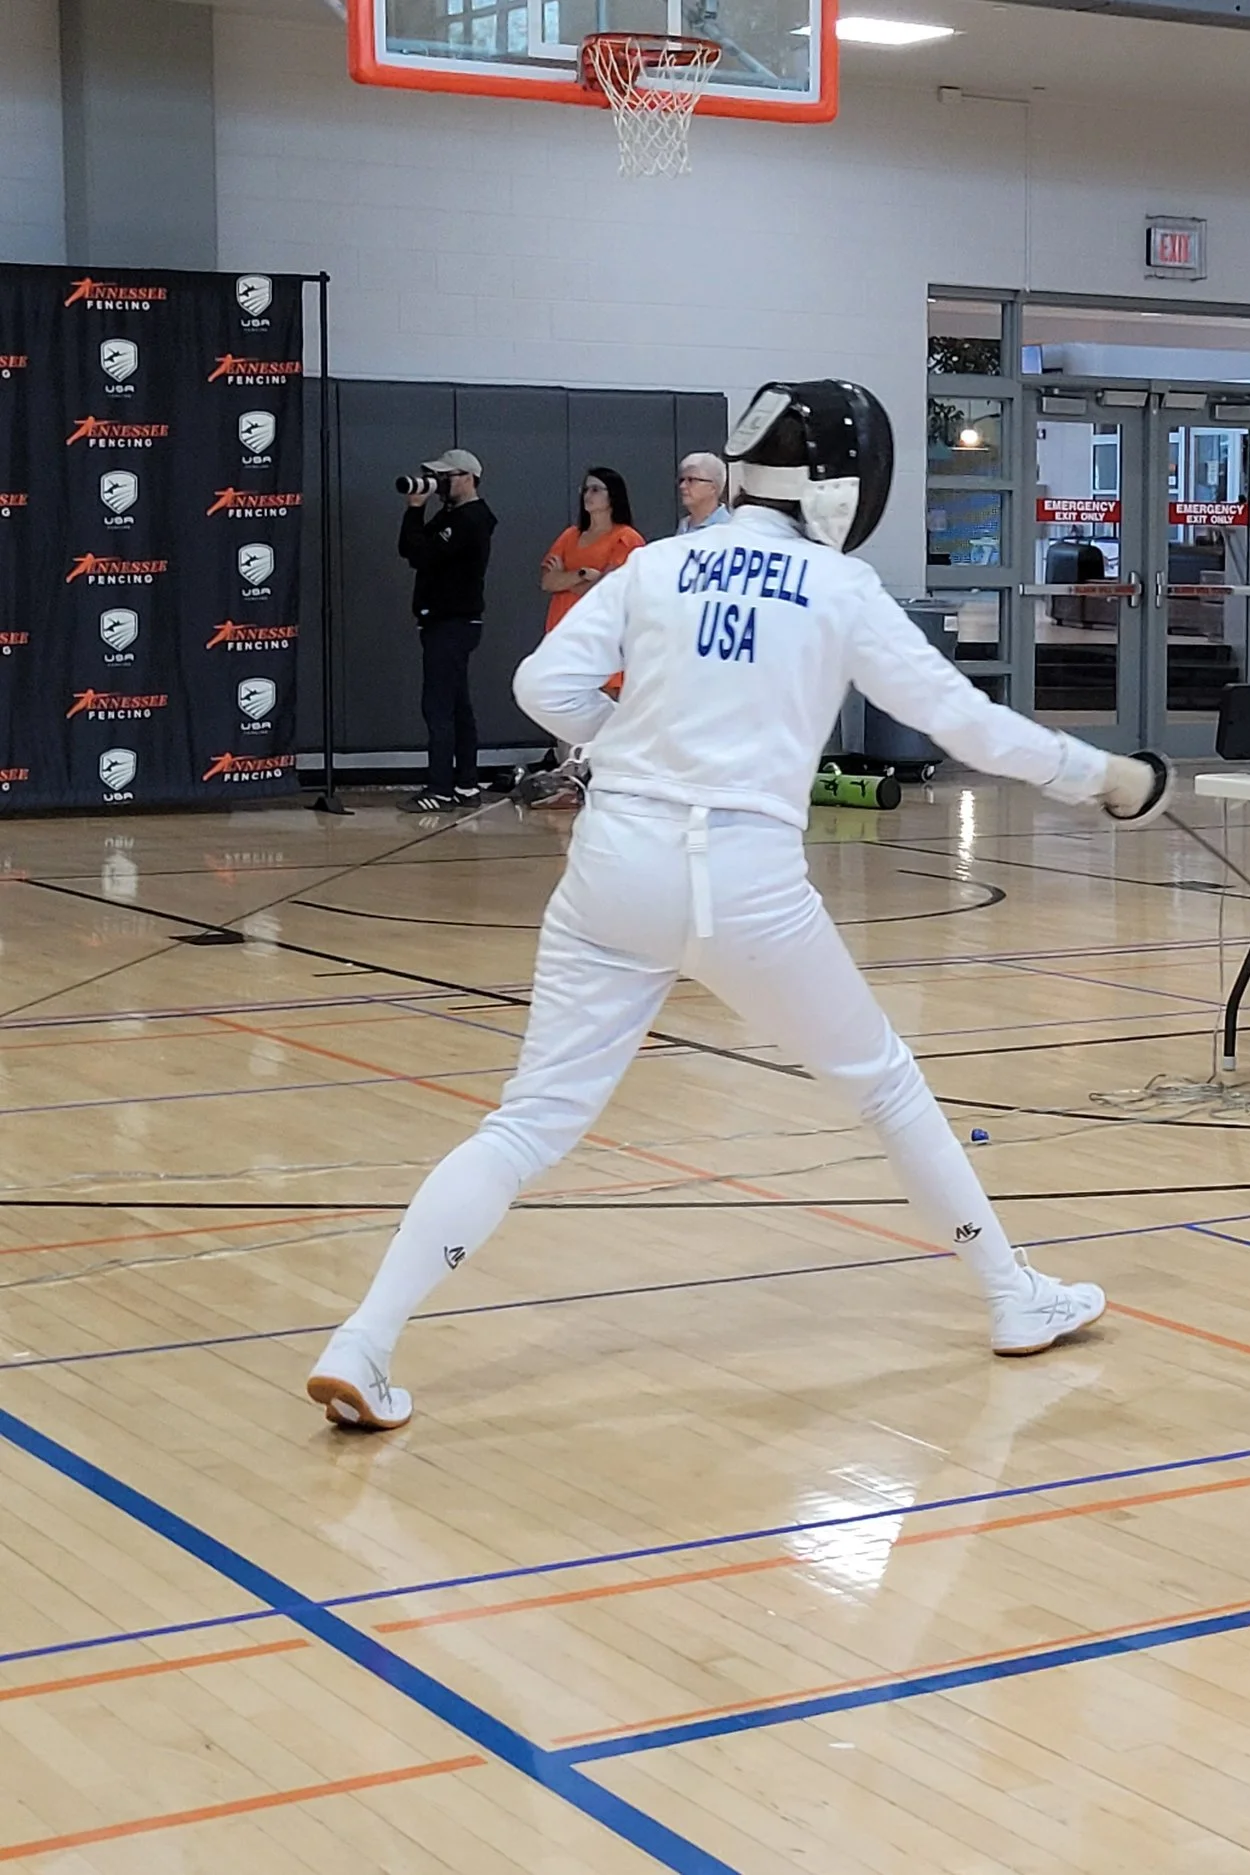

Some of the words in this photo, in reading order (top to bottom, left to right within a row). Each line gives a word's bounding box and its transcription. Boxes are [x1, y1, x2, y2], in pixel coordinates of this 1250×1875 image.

[1159, 233, 1191, 263] EXIT
[87, 300, 151, 310] FENCING
[228, 376, 286, 385] FENCING
[89, 438, 153, 448] FENCING
[1044, 500, 1116, 512] EMERGENCY
[1176, 504, 1244, 515] EMERGENCY
[228, 508, 287, 518] FENCING
[1055, 512, 1077, 521] EXIT
[1081, 512, 1106, 521] ONLY
[1186, 515, 1208, 524] EXIT
[1210, 515, 1235, 524] ONLY
[88, 575, 154, 585] FENCING
[678, 547, 808, 607] CHAPPELL
[697, 601, 756, 663] USA
[227, 640, 289, 651] FENCING
[88, 709, 152, 720] FENCING
